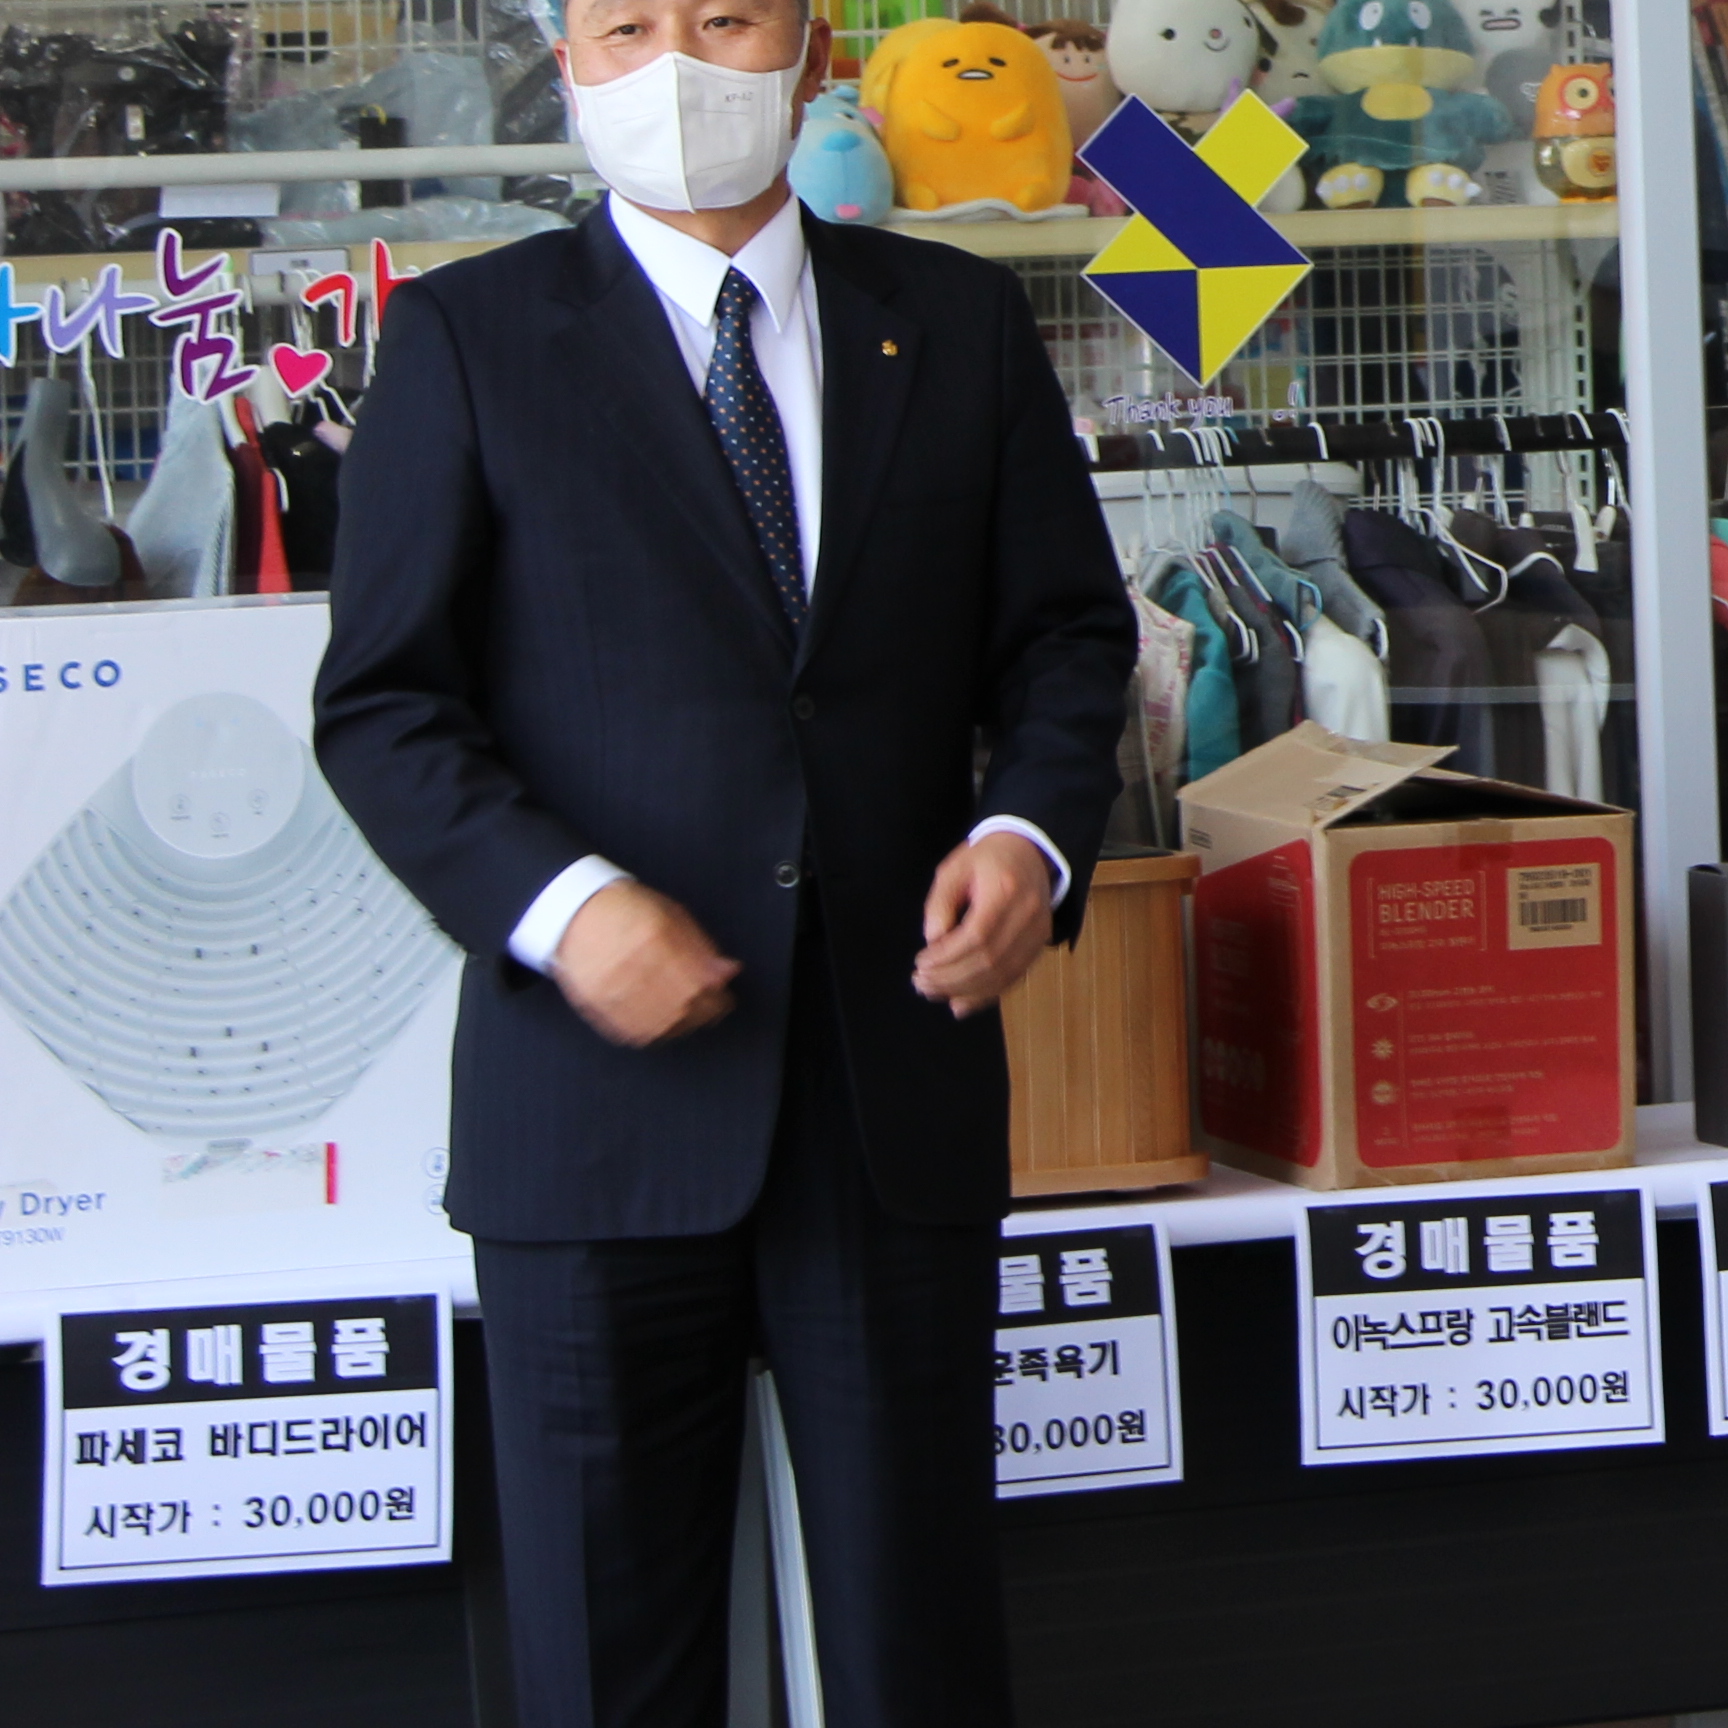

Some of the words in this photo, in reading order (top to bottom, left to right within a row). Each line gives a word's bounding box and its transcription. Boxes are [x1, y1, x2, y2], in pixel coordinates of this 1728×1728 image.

[1102, 390, 1182, 426] Thank
[1187, 394, 1234, 432] you
[1377, 878, 1476, 901] HIGH-SPEED
[1378, 898, 1476, 924] BLENDER
[21, 1192, 107, 1217] Dryer
[0, 1226, 66, 1246] 9130W
[1354, 1211, 1600, 1280] 경매물품
[1487, 1299, 1630, 1344] 고속블랜드
[112, 1317, 390, 1392] 경매물품
[1338, 1382, 1430, 1420] 시작가
[1476, 1371, 1630, 1412] 30,000원
[75, 1426, 185, 1467] 파세코
[208, 1411, 428, 1460] 바디드라이어
[84, 1499, 193, 1539] 시작가
[244, 1486, 417, 1530] 30,000원
